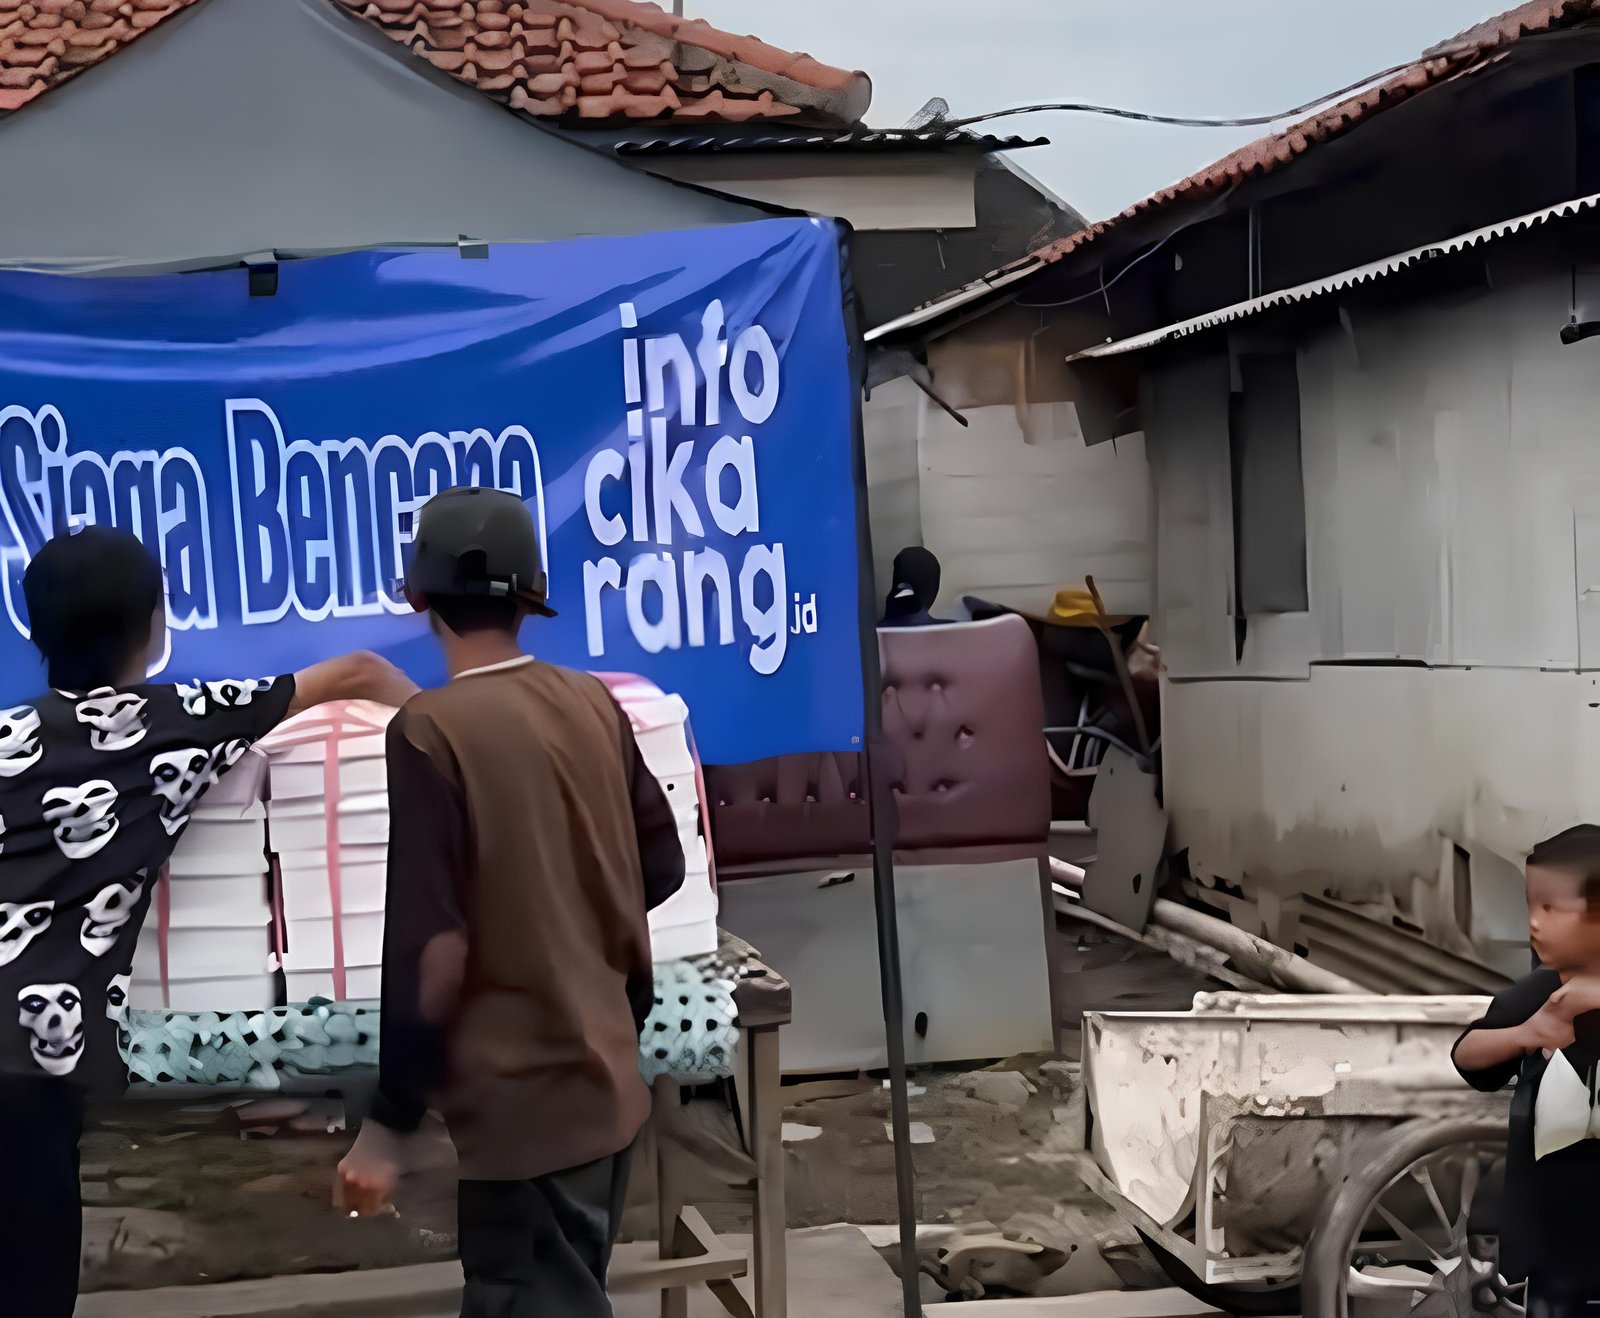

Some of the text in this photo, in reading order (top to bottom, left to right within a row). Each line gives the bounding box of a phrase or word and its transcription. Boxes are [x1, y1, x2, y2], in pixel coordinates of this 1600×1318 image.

[619, 298, 780, 427] info
[584, 408, 760, 546] cika
[582, 542, 787, 676] rang
